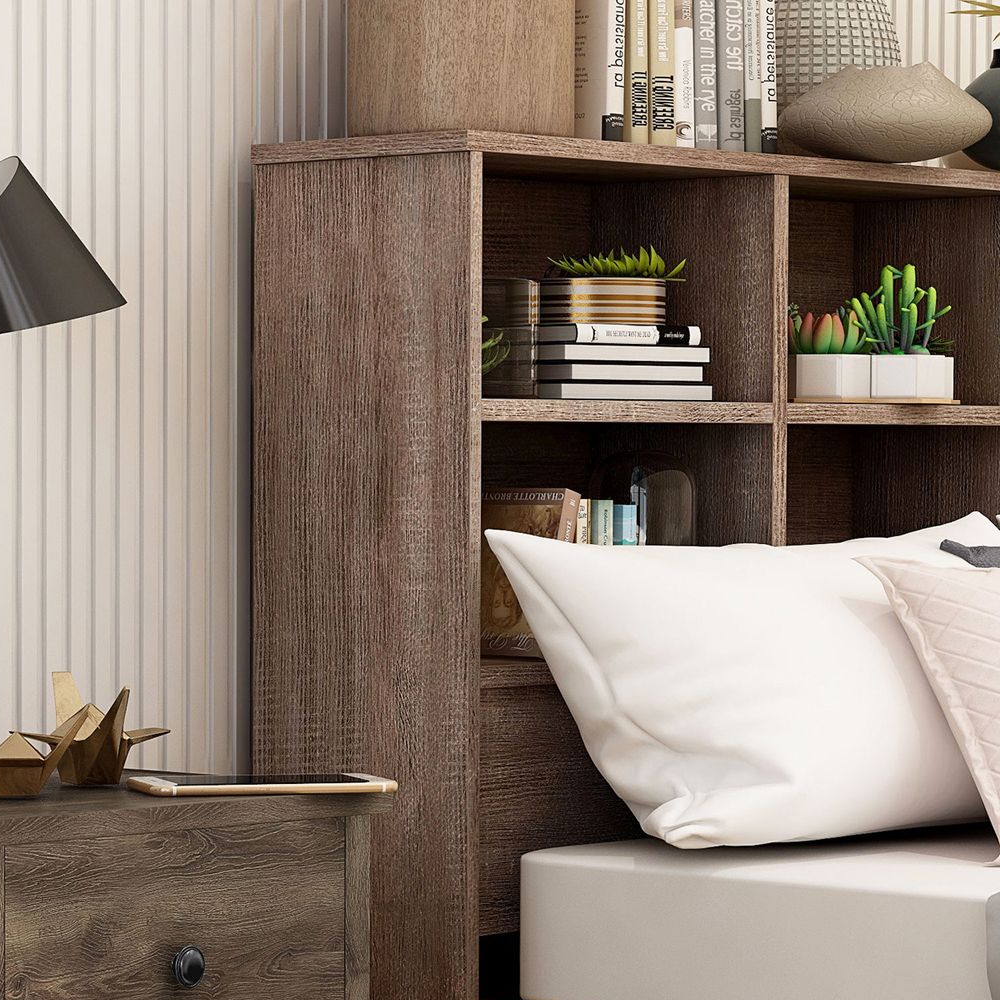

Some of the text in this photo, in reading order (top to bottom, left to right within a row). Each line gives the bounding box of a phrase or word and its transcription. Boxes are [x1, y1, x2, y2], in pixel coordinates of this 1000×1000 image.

[700, 46, 716, 59] in
[700, 63, 717, 86] the
[694, 89, 716, 112] rye
[513, 492, 565, 502] CHARLOTTE
